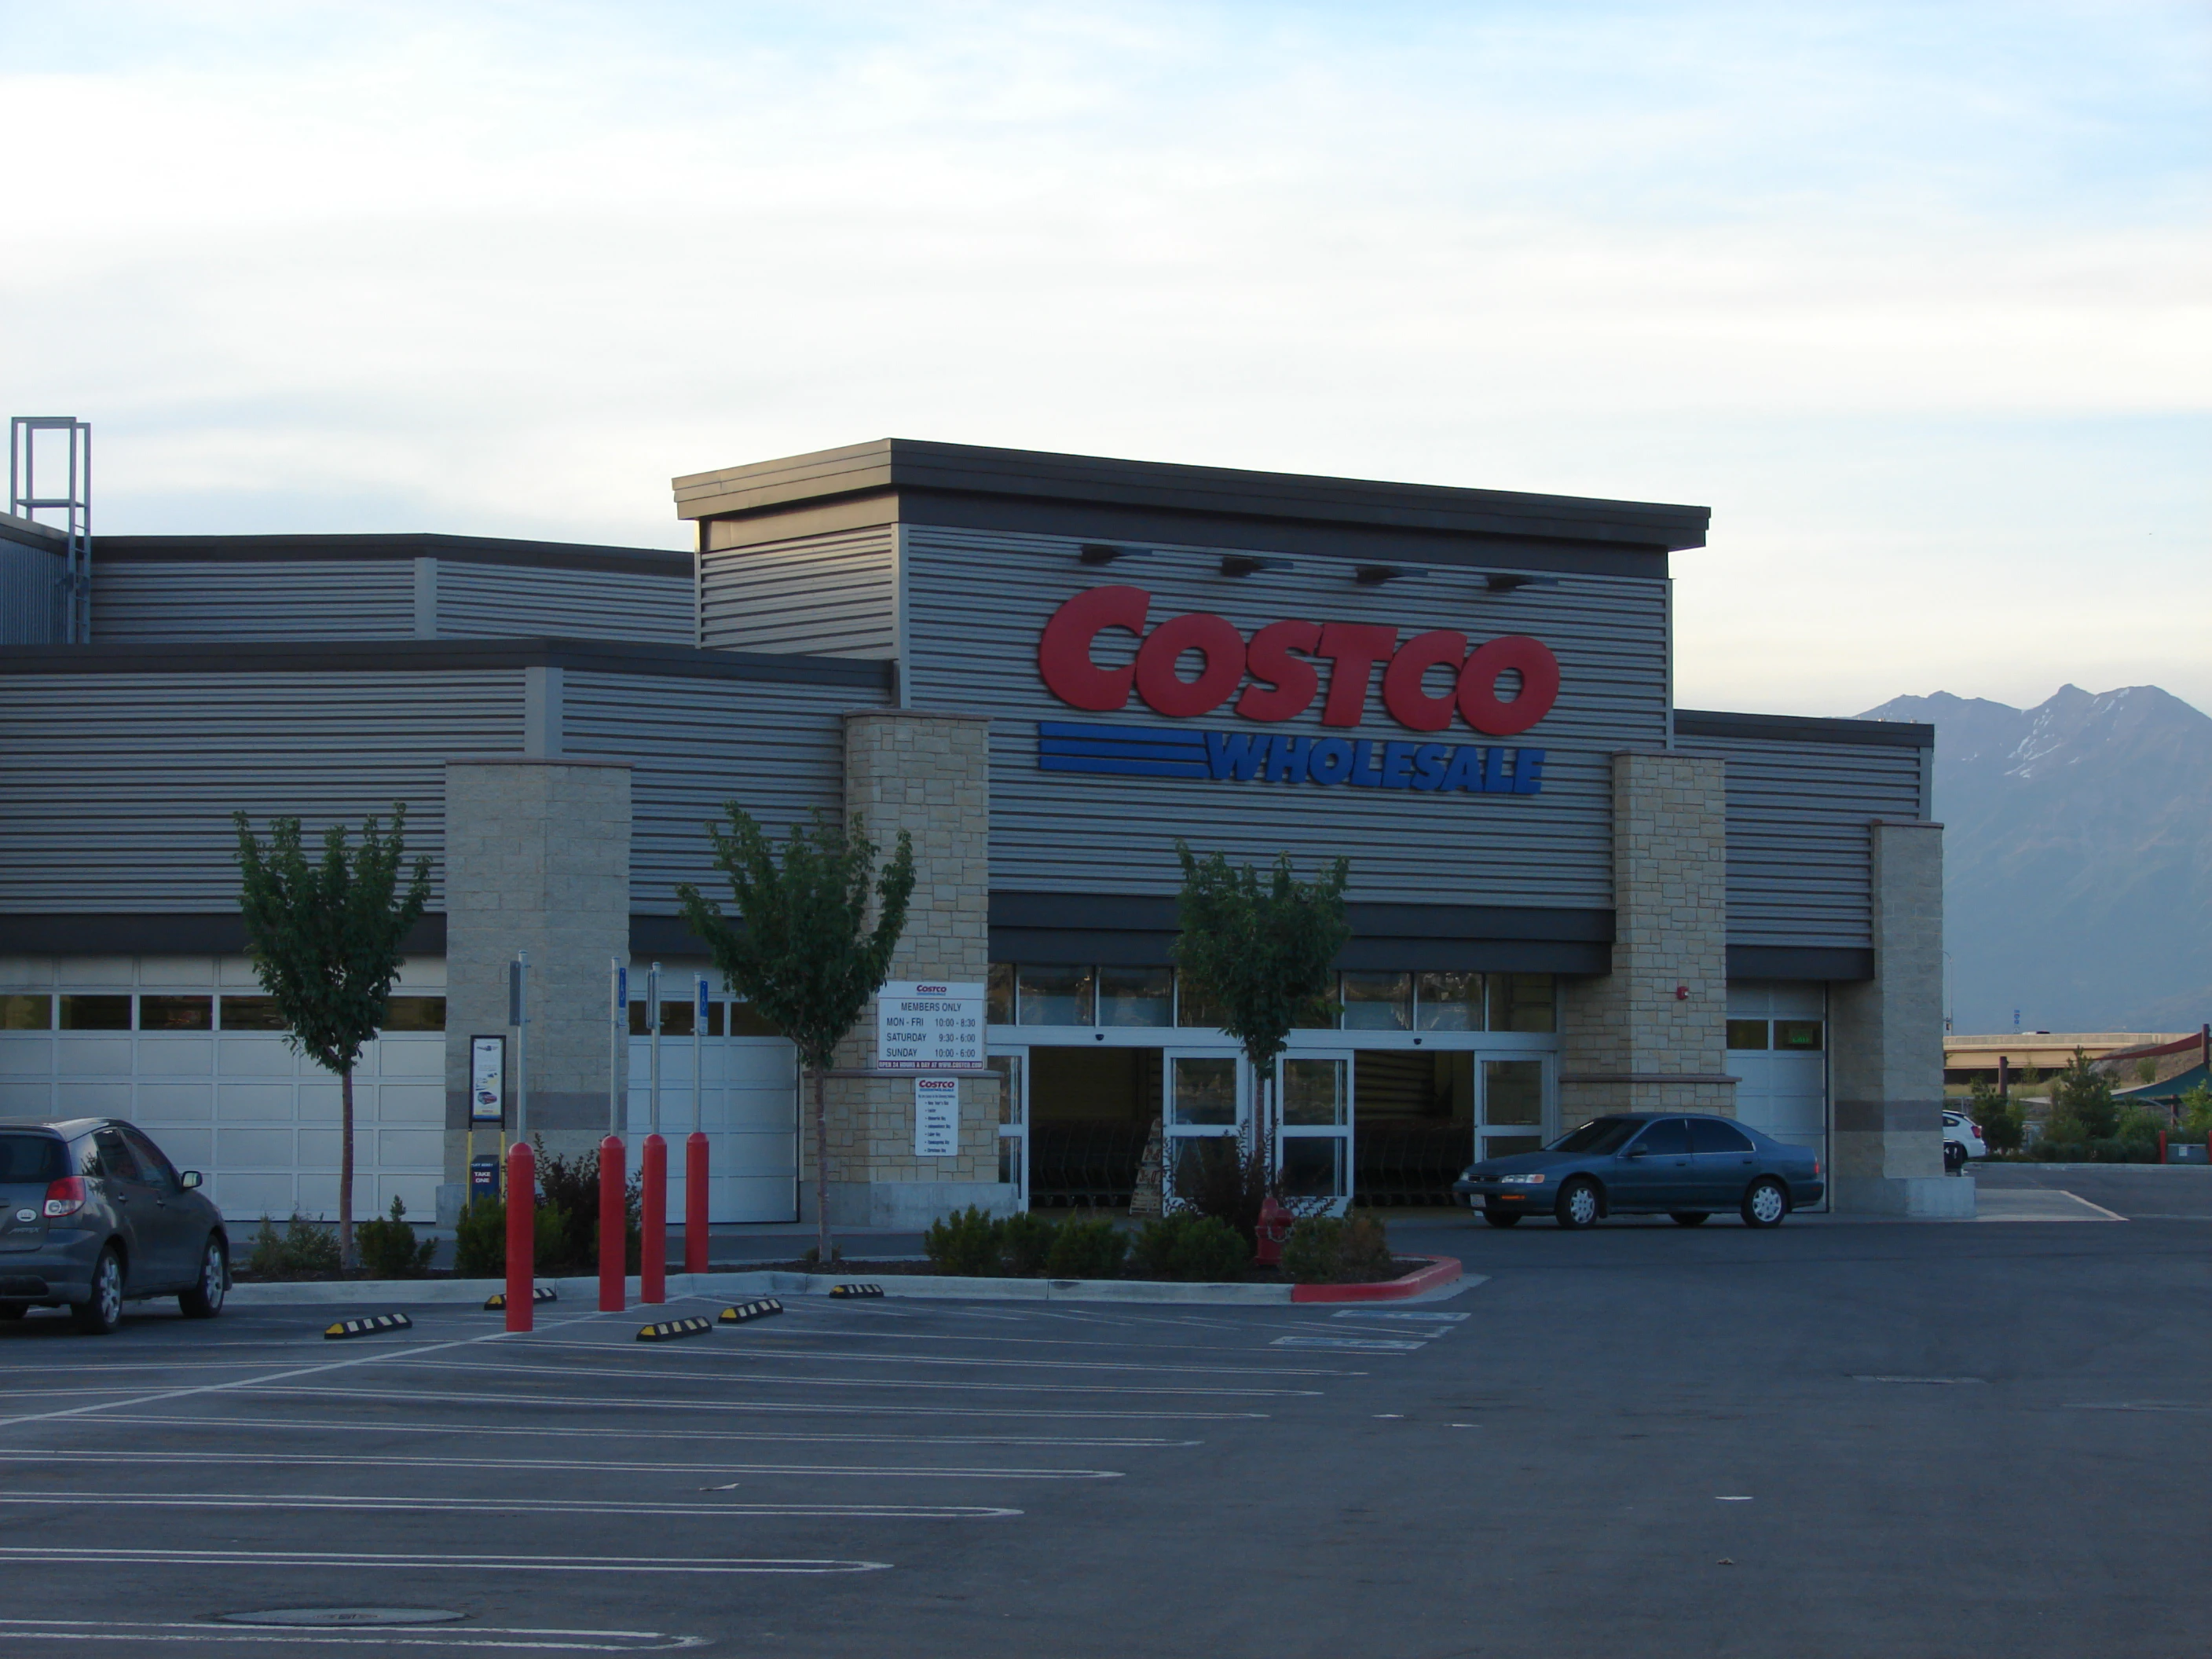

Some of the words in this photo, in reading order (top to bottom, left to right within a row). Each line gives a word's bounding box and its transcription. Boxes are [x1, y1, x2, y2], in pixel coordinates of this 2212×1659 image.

[1038, 584, 1560, 736] COSTCO
[1205, 731, 1546, 795] WHOLESALE
[901, 1002, 939, 1012] MEMBERS
[942, 1003, 961, 1012] ONLY
[887, 1017, 904, 1027] MON
[911, 1018, 924, 1027] FRI
[936, 1018, 954, 1027] 10:00
[961, 1019, 976, 1027] 8:30
[887, 1033, 926, 1042] SATURDAY
[939, 1034, 954, 1042] 9:30
[960, 1034, 976, 1042] 6:00
[886, 1048, 917, 1057] SUNDAY
[935, 1049, 954, 1057] 10:00
[960, 1049, 976, 1057] 6:00
[918, 1079, 954, 1088] COSTCO
